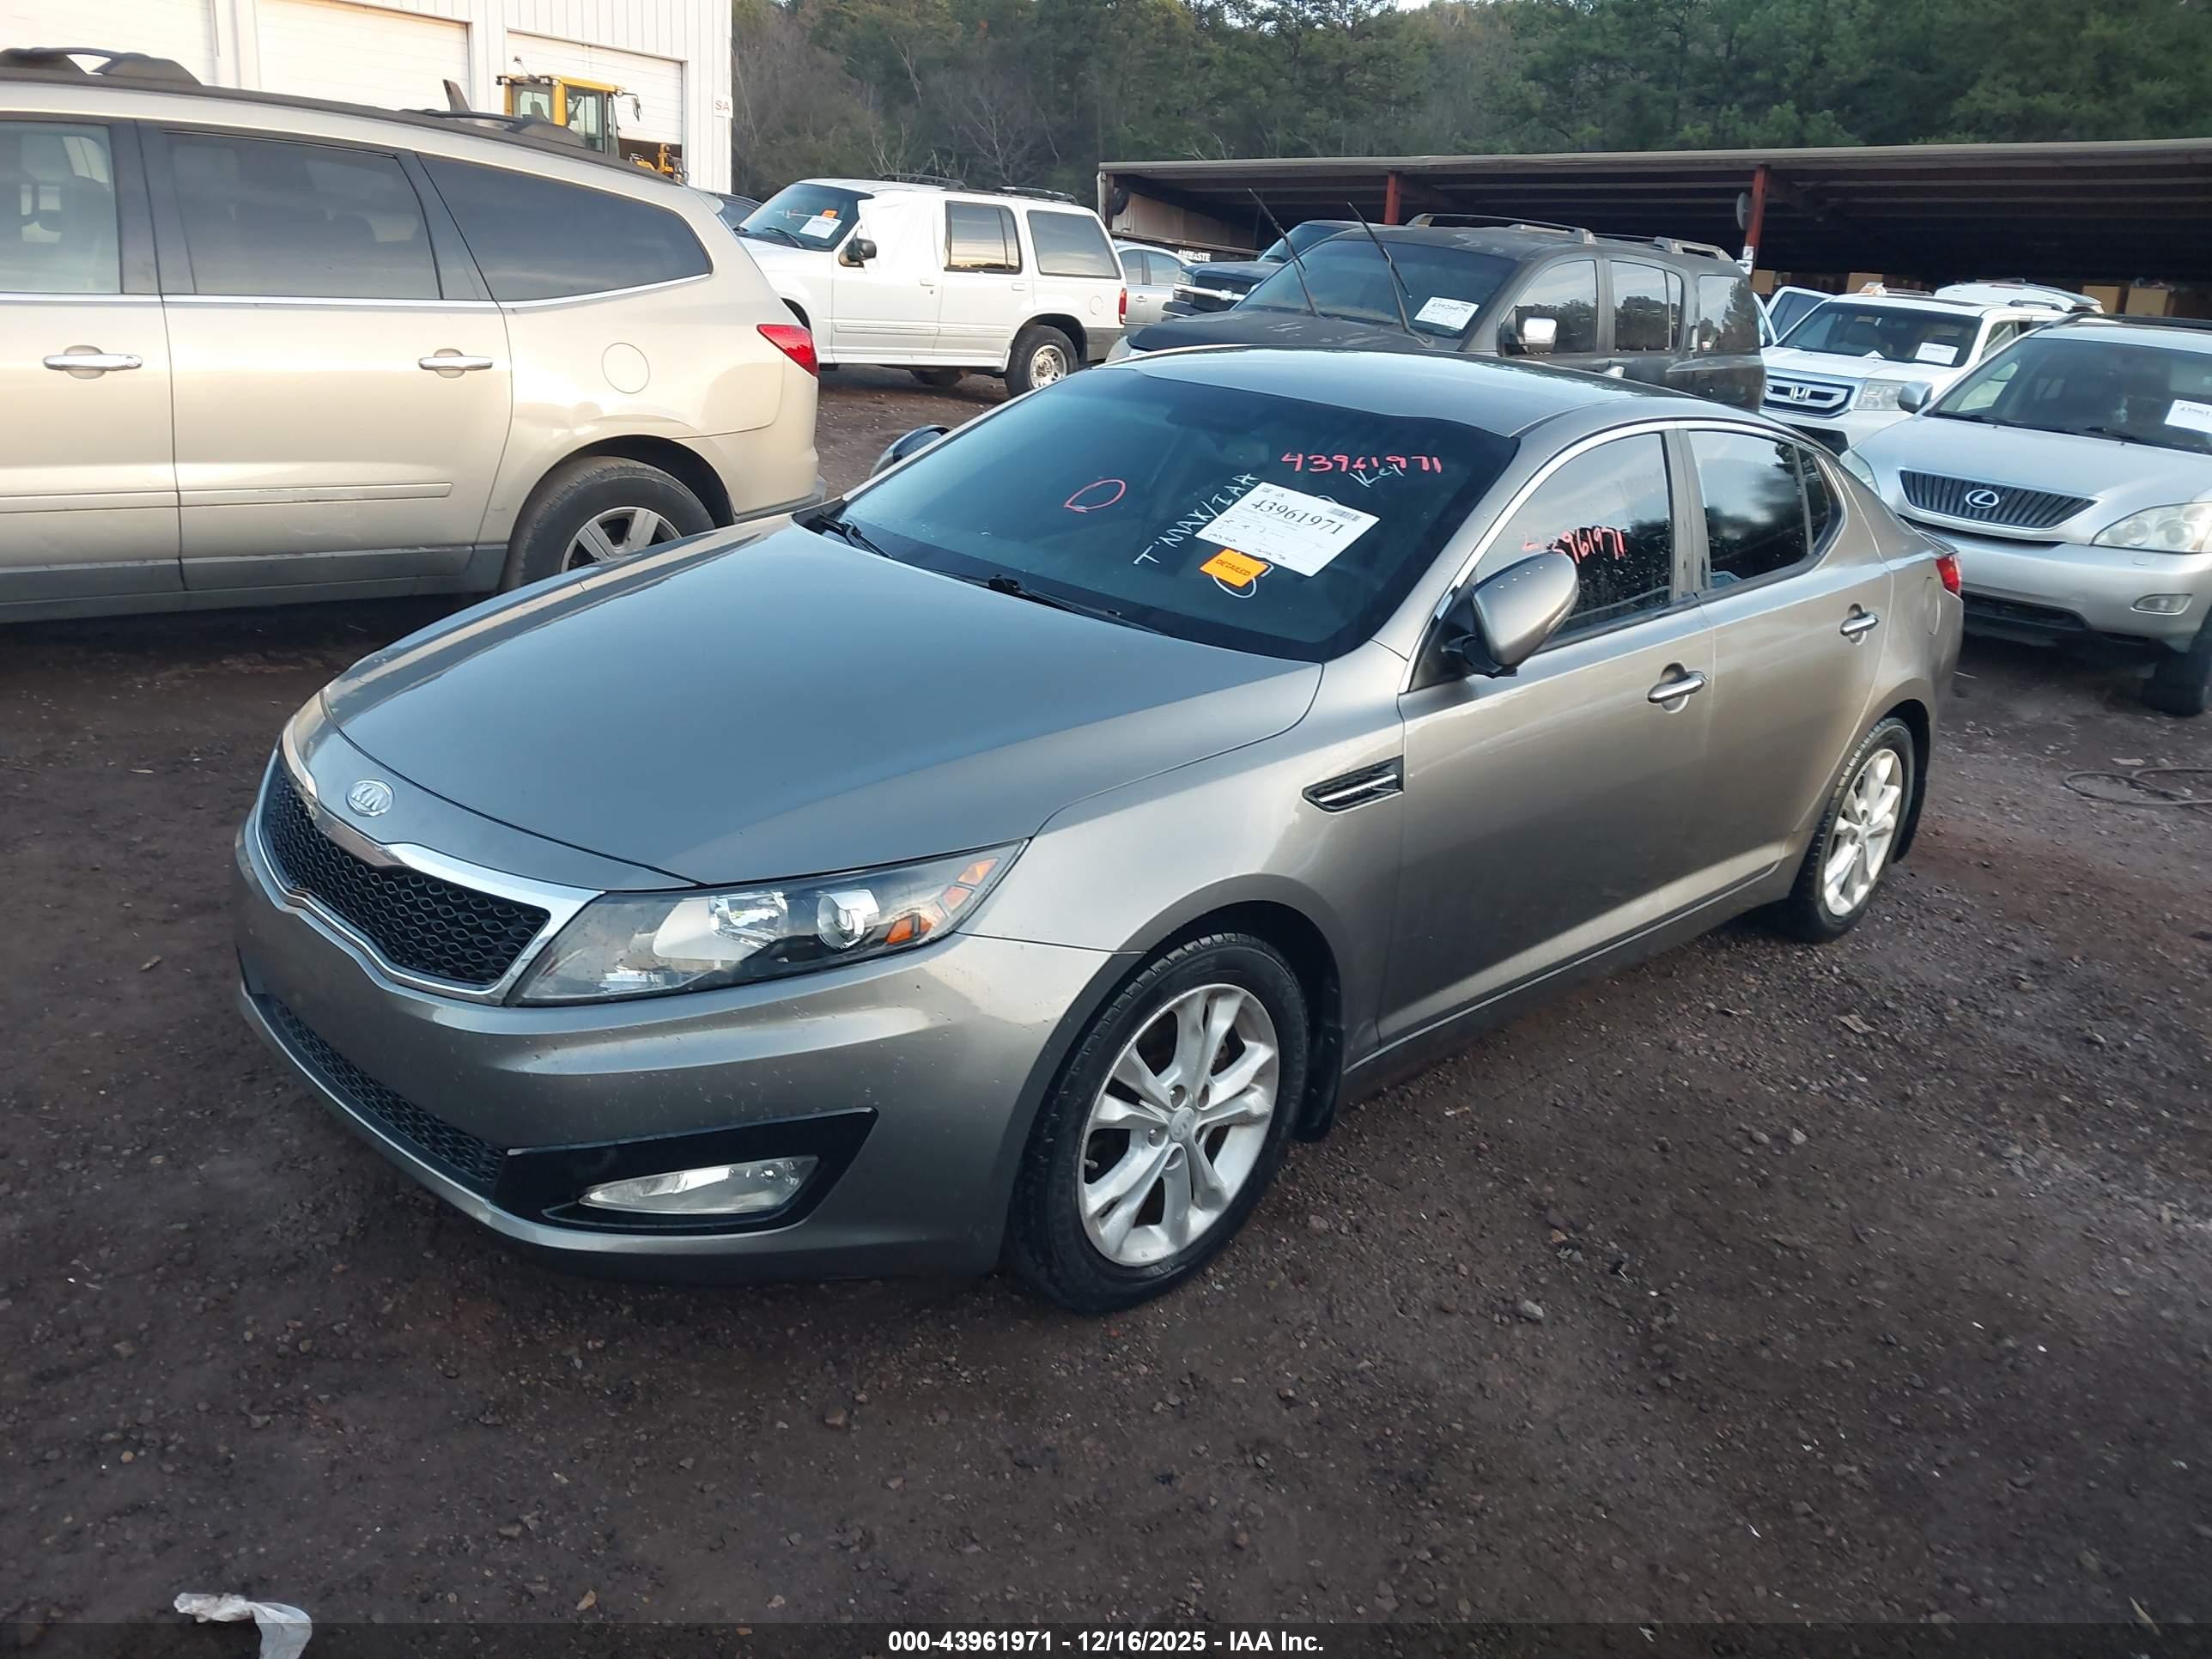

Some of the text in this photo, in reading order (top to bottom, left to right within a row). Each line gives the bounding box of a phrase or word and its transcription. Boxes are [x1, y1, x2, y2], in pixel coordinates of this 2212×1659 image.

[1281, 452, 1443, 473] 43961971
[1250, 498, 1346, 536] 43961971
[1215, 558, 1251, 577] DETAILED
